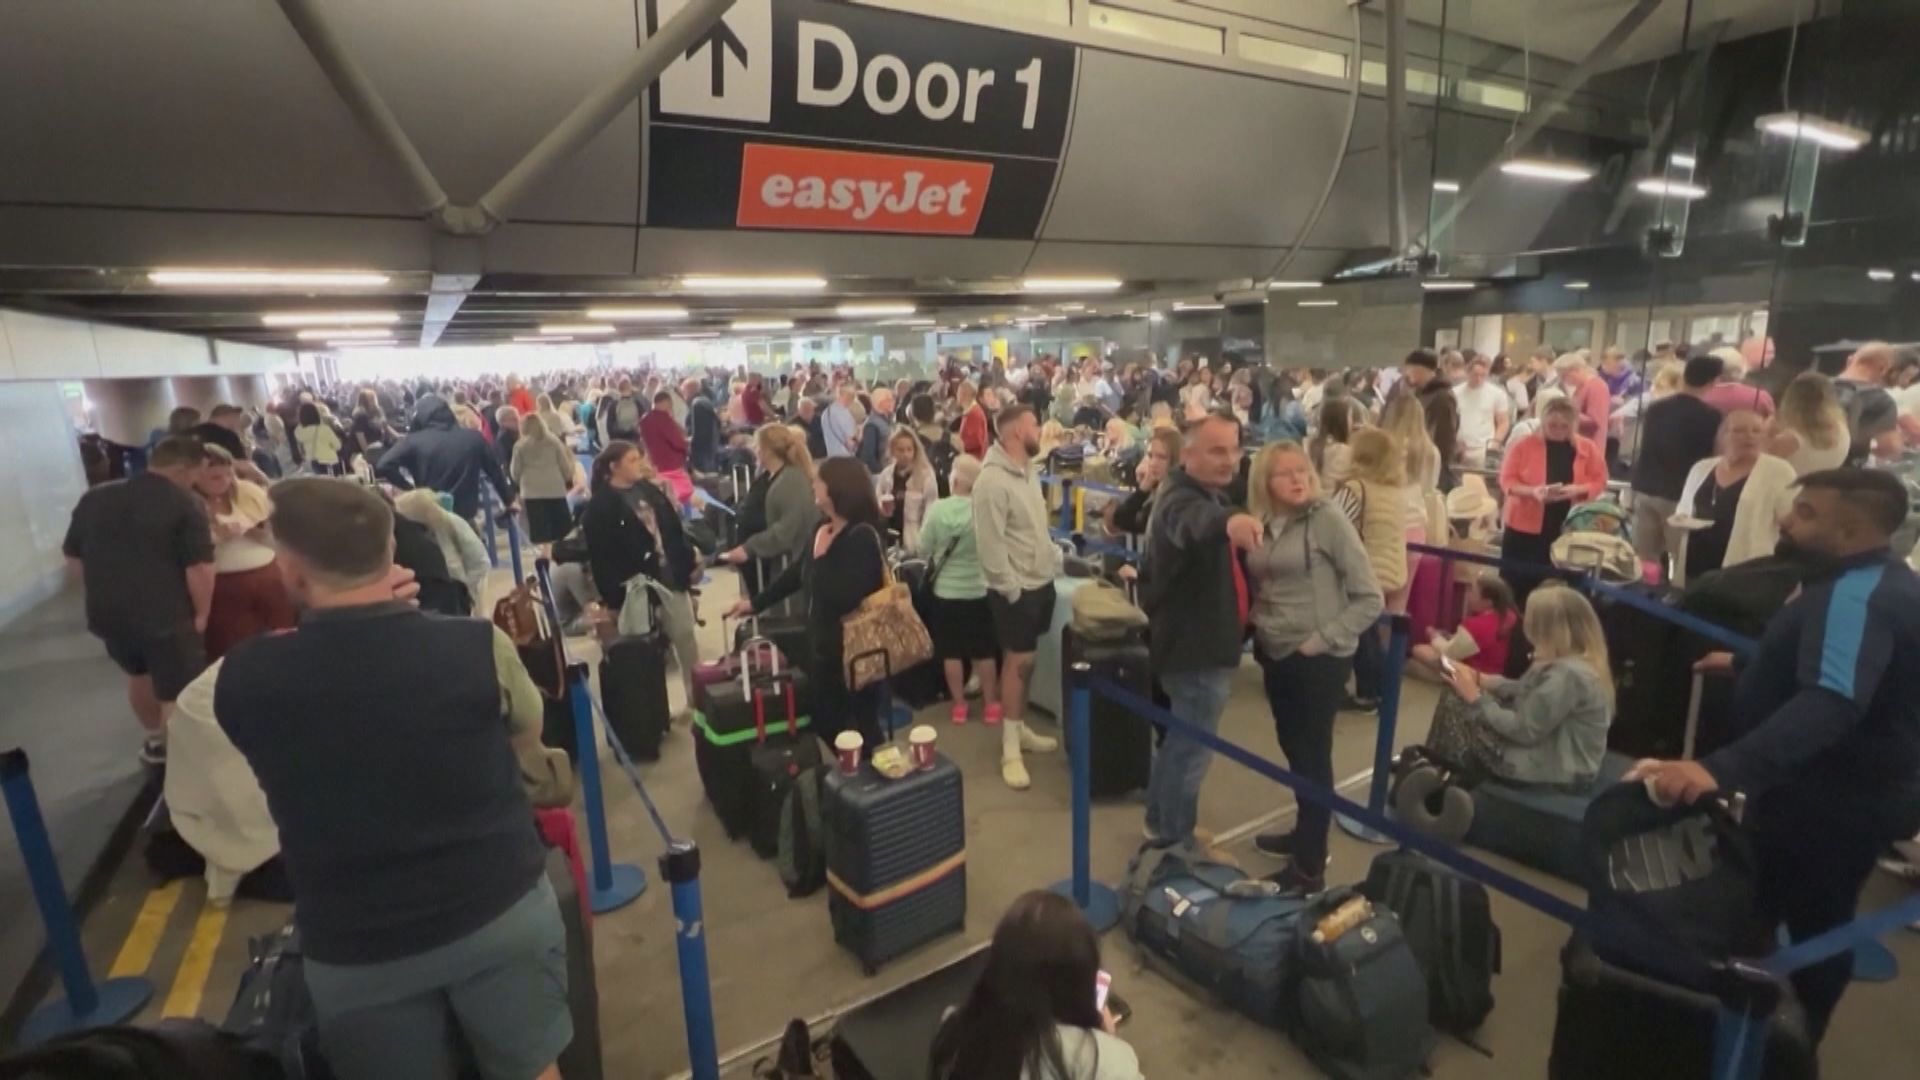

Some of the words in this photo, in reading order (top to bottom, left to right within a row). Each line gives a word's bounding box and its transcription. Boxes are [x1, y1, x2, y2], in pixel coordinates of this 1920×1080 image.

[797, 20, 995, 122] Door
[1015, 58, 1042, 129] 1
[761, 171, 972, 219] easyJet
